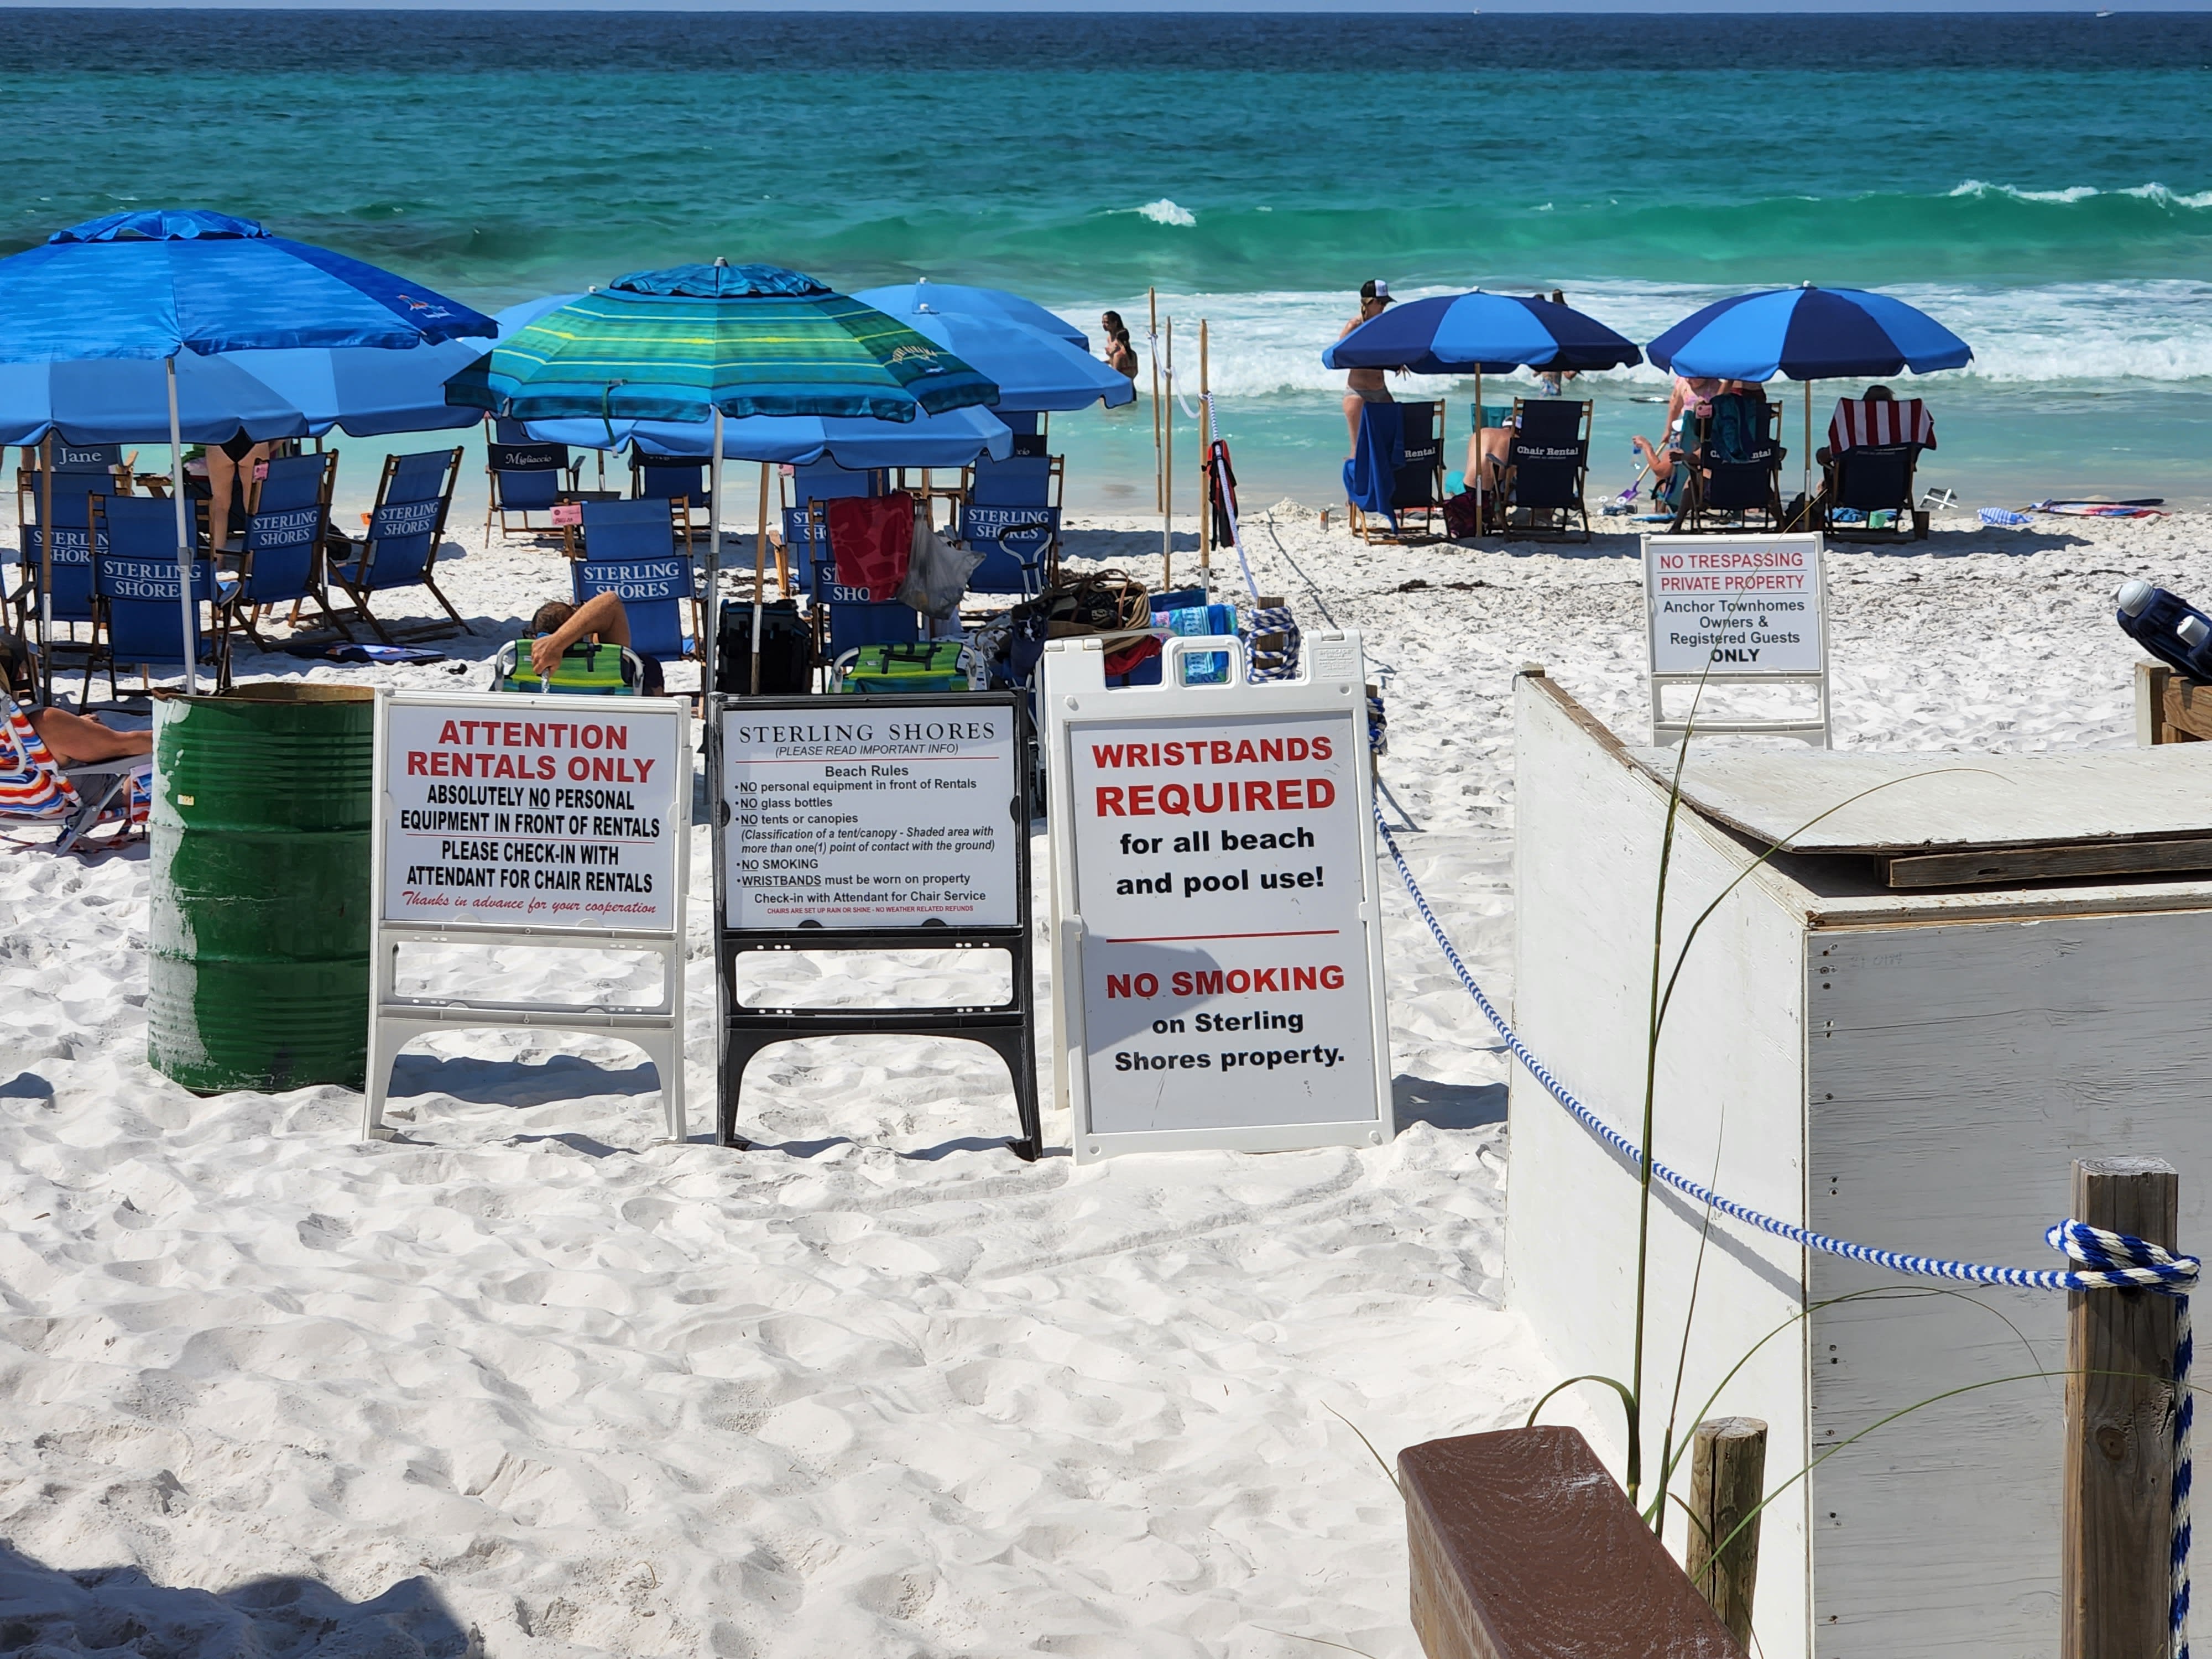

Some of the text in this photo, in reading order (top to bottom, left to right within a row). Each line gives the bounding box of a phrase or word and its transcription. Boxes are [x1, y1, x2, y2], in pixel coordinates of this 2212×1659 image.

[59, 447, 102, 465] Jane
[1404, 447, 1436, 458] Rental
[1517, 446, 1578, 456] Chair Rental
[1751, 448, 1771, 458] ntal
[253, 510, 317, 530] STERLING
[379, 502, 439, 521] STERLING
[969, 509, 1048, 524] STERLING
[384, 519, 430, 536] SHORES
[260, 529, 310, 546] SHORES
[1661, 553, 1802, 568] NO TRESPASSING
[584, 562, 680, 580] STERLING
[115, 581, 181, 598] SHORE
[1662, 575, 1804, 591] PRIVATE PROPERTY
[1664, 599, 1804, 612] Anchor Townhomes
[1700, 615, 1768, 628] Owners &
[1671, 632, 1799, 648] Registered Guests
[1712, 649, 1760, 662] ONLY
[439, 721, 627, 749] ATTENTION
[740, 723, 994, 743] STERLING SHORES
[776, 744, 958, 758] (PLEASE READ IMPORTANT INFO)
[1092, 737, 1332, 768] WRISTBANDS
[408, 752, 655, 783] RENTALS ONLY
[826, 765, 909, 777] Beach Rules
[740, 779, 976, 794] NO personal equipment in front of Rentals
[427, 785, 634, 810] ABSOLUTELY NO PERSONAL
[741, 797, 832, 810] NO glass bottles
[1097, 779, 1335, 817] REQUIRED
[401, 810, 659, 837] EQUIPMENT IN FRONT OF RENTALS
[741, 815, 758, 824] NO
[761, 815, 789, 824] tents
[808, 813, 858, 825] canopies
[742, 829, 812, 842] (Classification
[816, 828, 827, 838] of
[838, 828, 897, 839] tent/canopy
[907, 827, 945, 837] Shaded
[973, 826, 993, 836] with
[1120, 827, 1314, 854] for all beach
[442, 841, 618, 865] PLEASE CHECK-IN WITH
[771, 843, 792, 853] than
[796, 842, 826, 854] one(1)
[830, 842, 855, 854] point
[859, 842, 869, 851] of
[872, 842, 909, 851] contact
[912, 841, 932, 851] with
[937, 841, 952, 850] the
[955, 840, 994, 853] ground)
[742, 859, 818, 869] NO SMOKING
[407, 866, 652, 893] ATTENDANT FOR CHAIR RENTALS
[742, 875, 821, 885] WRISTBANDS
[825, 875, 853, 885] must
[857, 874, 869, 884] be
[923, 874, 970, 885] property
[1117, 867, 1323, 898] and pool use!
[403, 891, 655, 915] Thanks in advance for your cooperation
[755, 891, 985, 903] Check-in with Attendant for Chair Service
[1107, 966, 1344, 998] NO SMOKING
[1152, 1011, 1303, 1034] on Sterling
[1115, 1044, 1344, 1072] Shores property.
